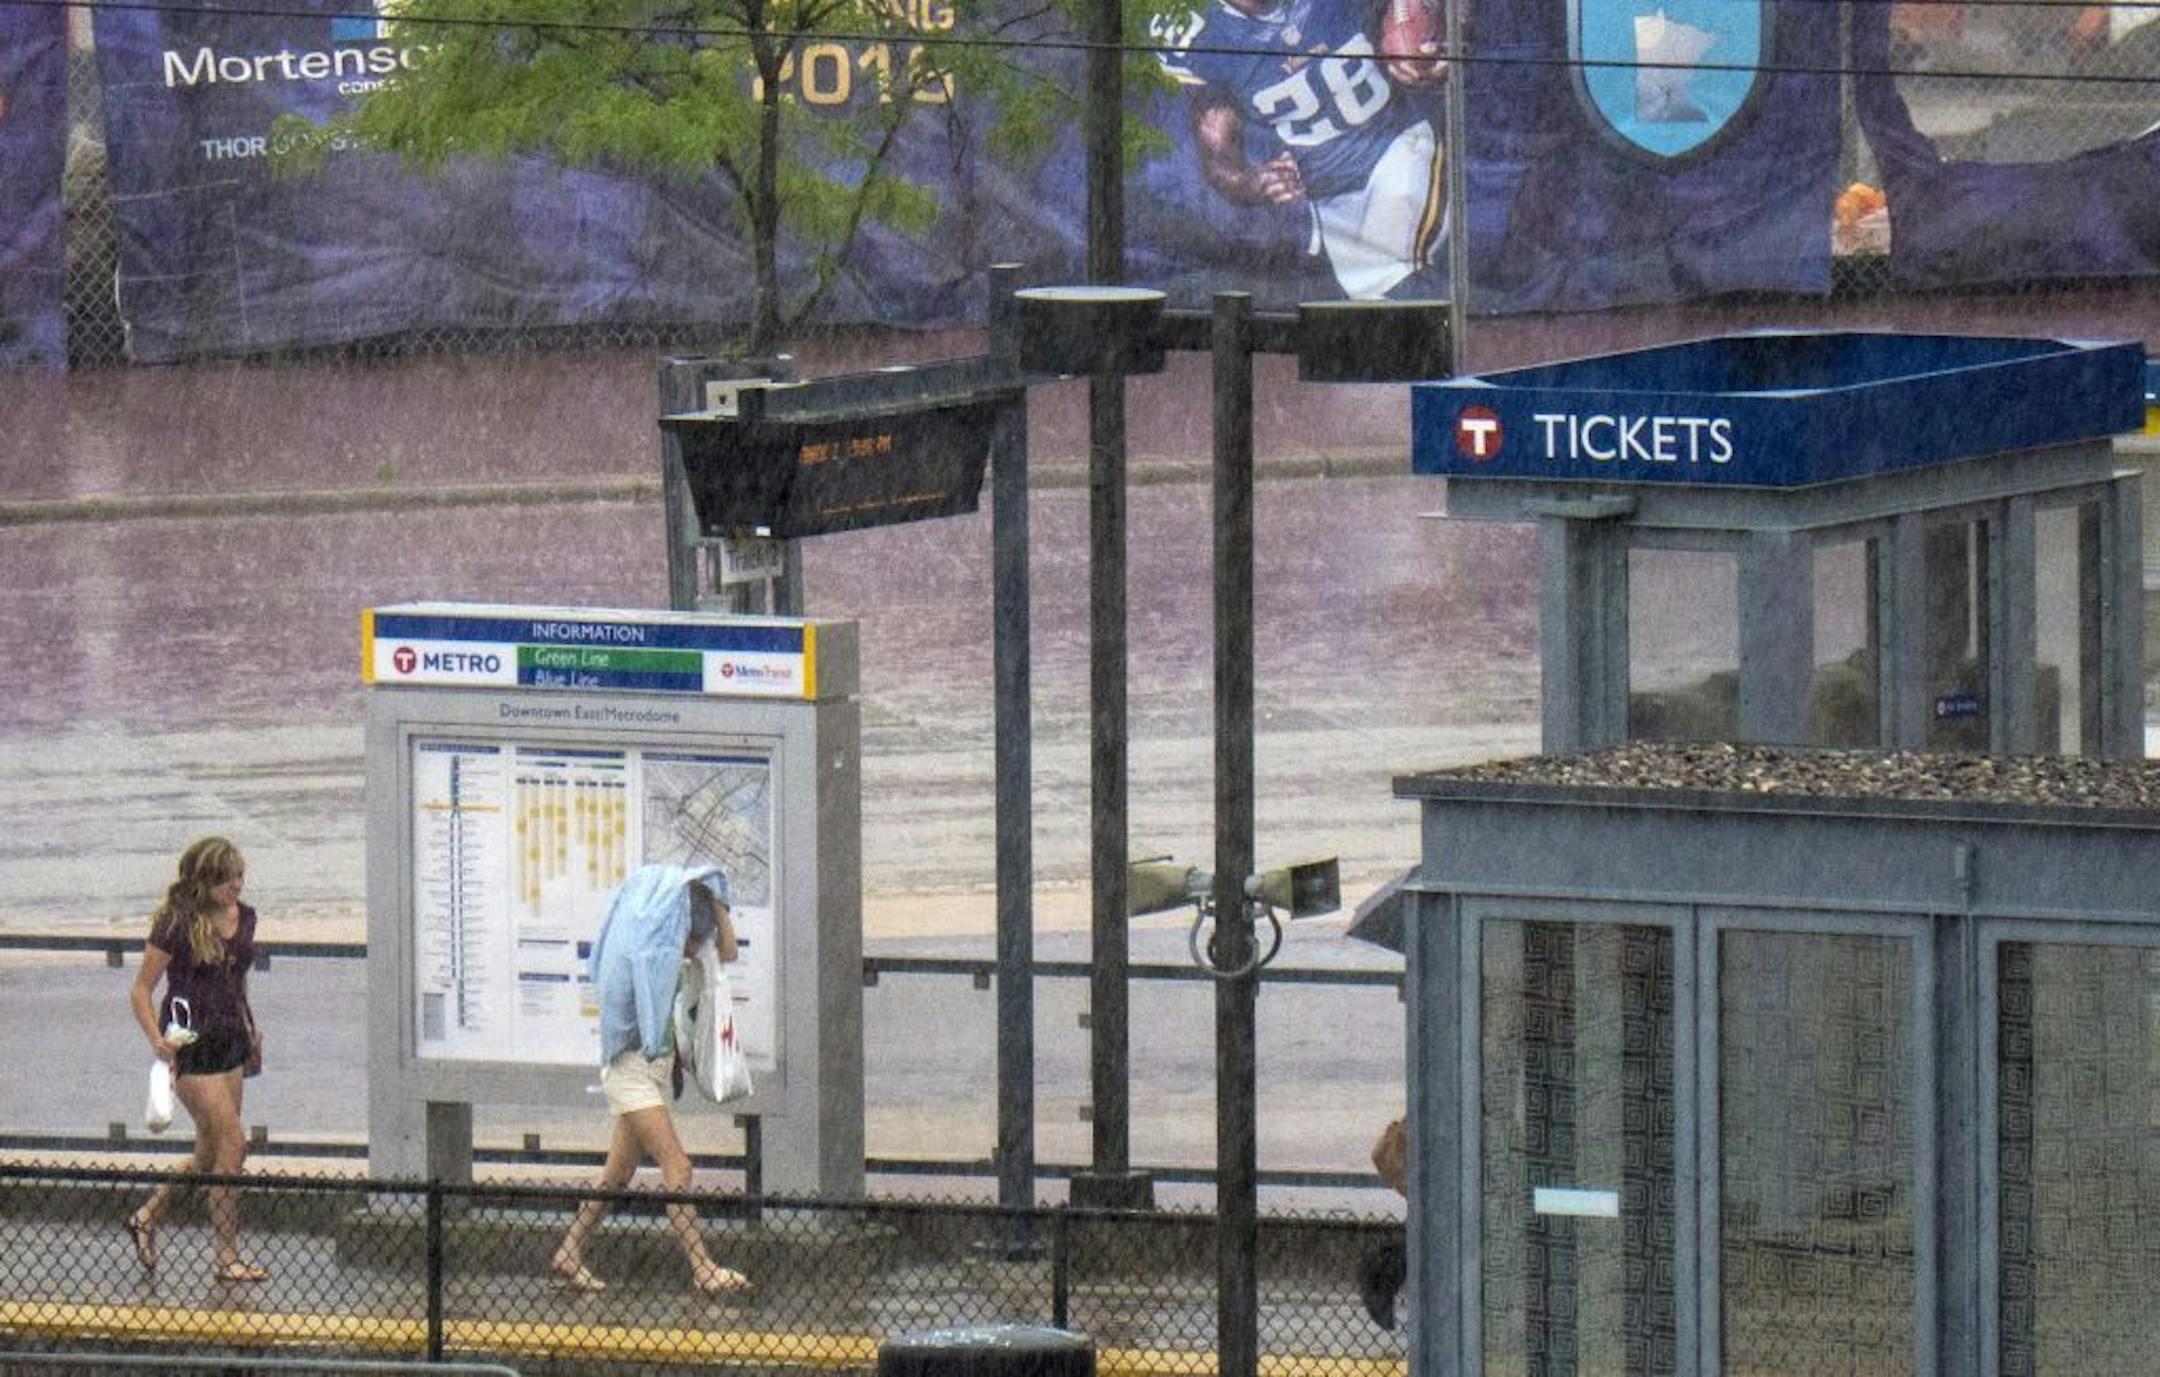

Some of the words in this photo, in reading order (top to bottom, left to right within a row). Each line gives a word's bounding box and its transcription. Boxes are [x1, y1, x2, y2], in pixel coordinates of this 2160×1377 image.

[163, 45, 445, 87] Mortenso
[1252, 33, 1391, 146] 28
[201, 136, 267, 160] THOR
[1533, 413, 1734, 463] TICKETS
[532, 623, 645, 642] INFORMATION
[423, 652, 501, 674] METRO
[535, 646, 577, 667] Green
[581, 648, 609, 667] Line
[499, 703, 572, 718] Downtown
